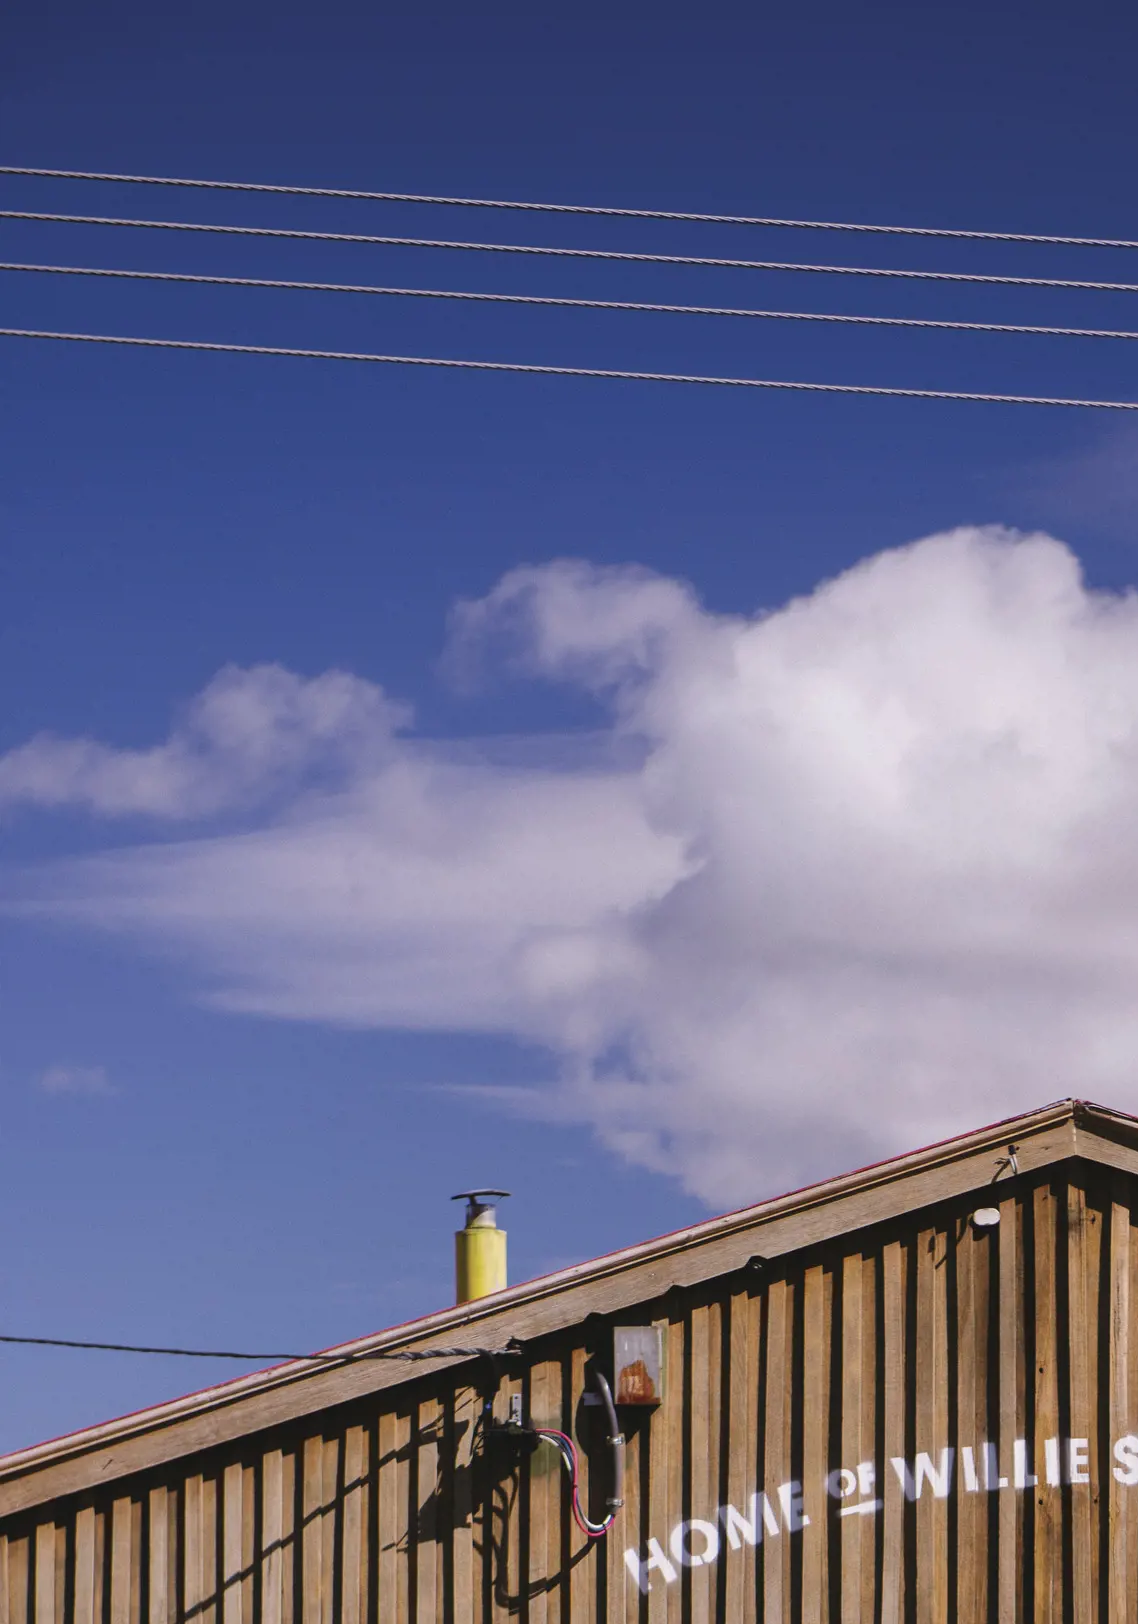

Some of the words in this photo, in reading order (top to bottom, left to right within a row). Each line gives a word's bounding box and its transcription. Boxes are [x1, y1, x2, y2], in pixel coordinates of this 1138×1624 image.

[623, 1479, 811, 1594] HOME
[825, 1460, 879, 1514] OF
[890, 1438, 1090, 1501] WILLIE
